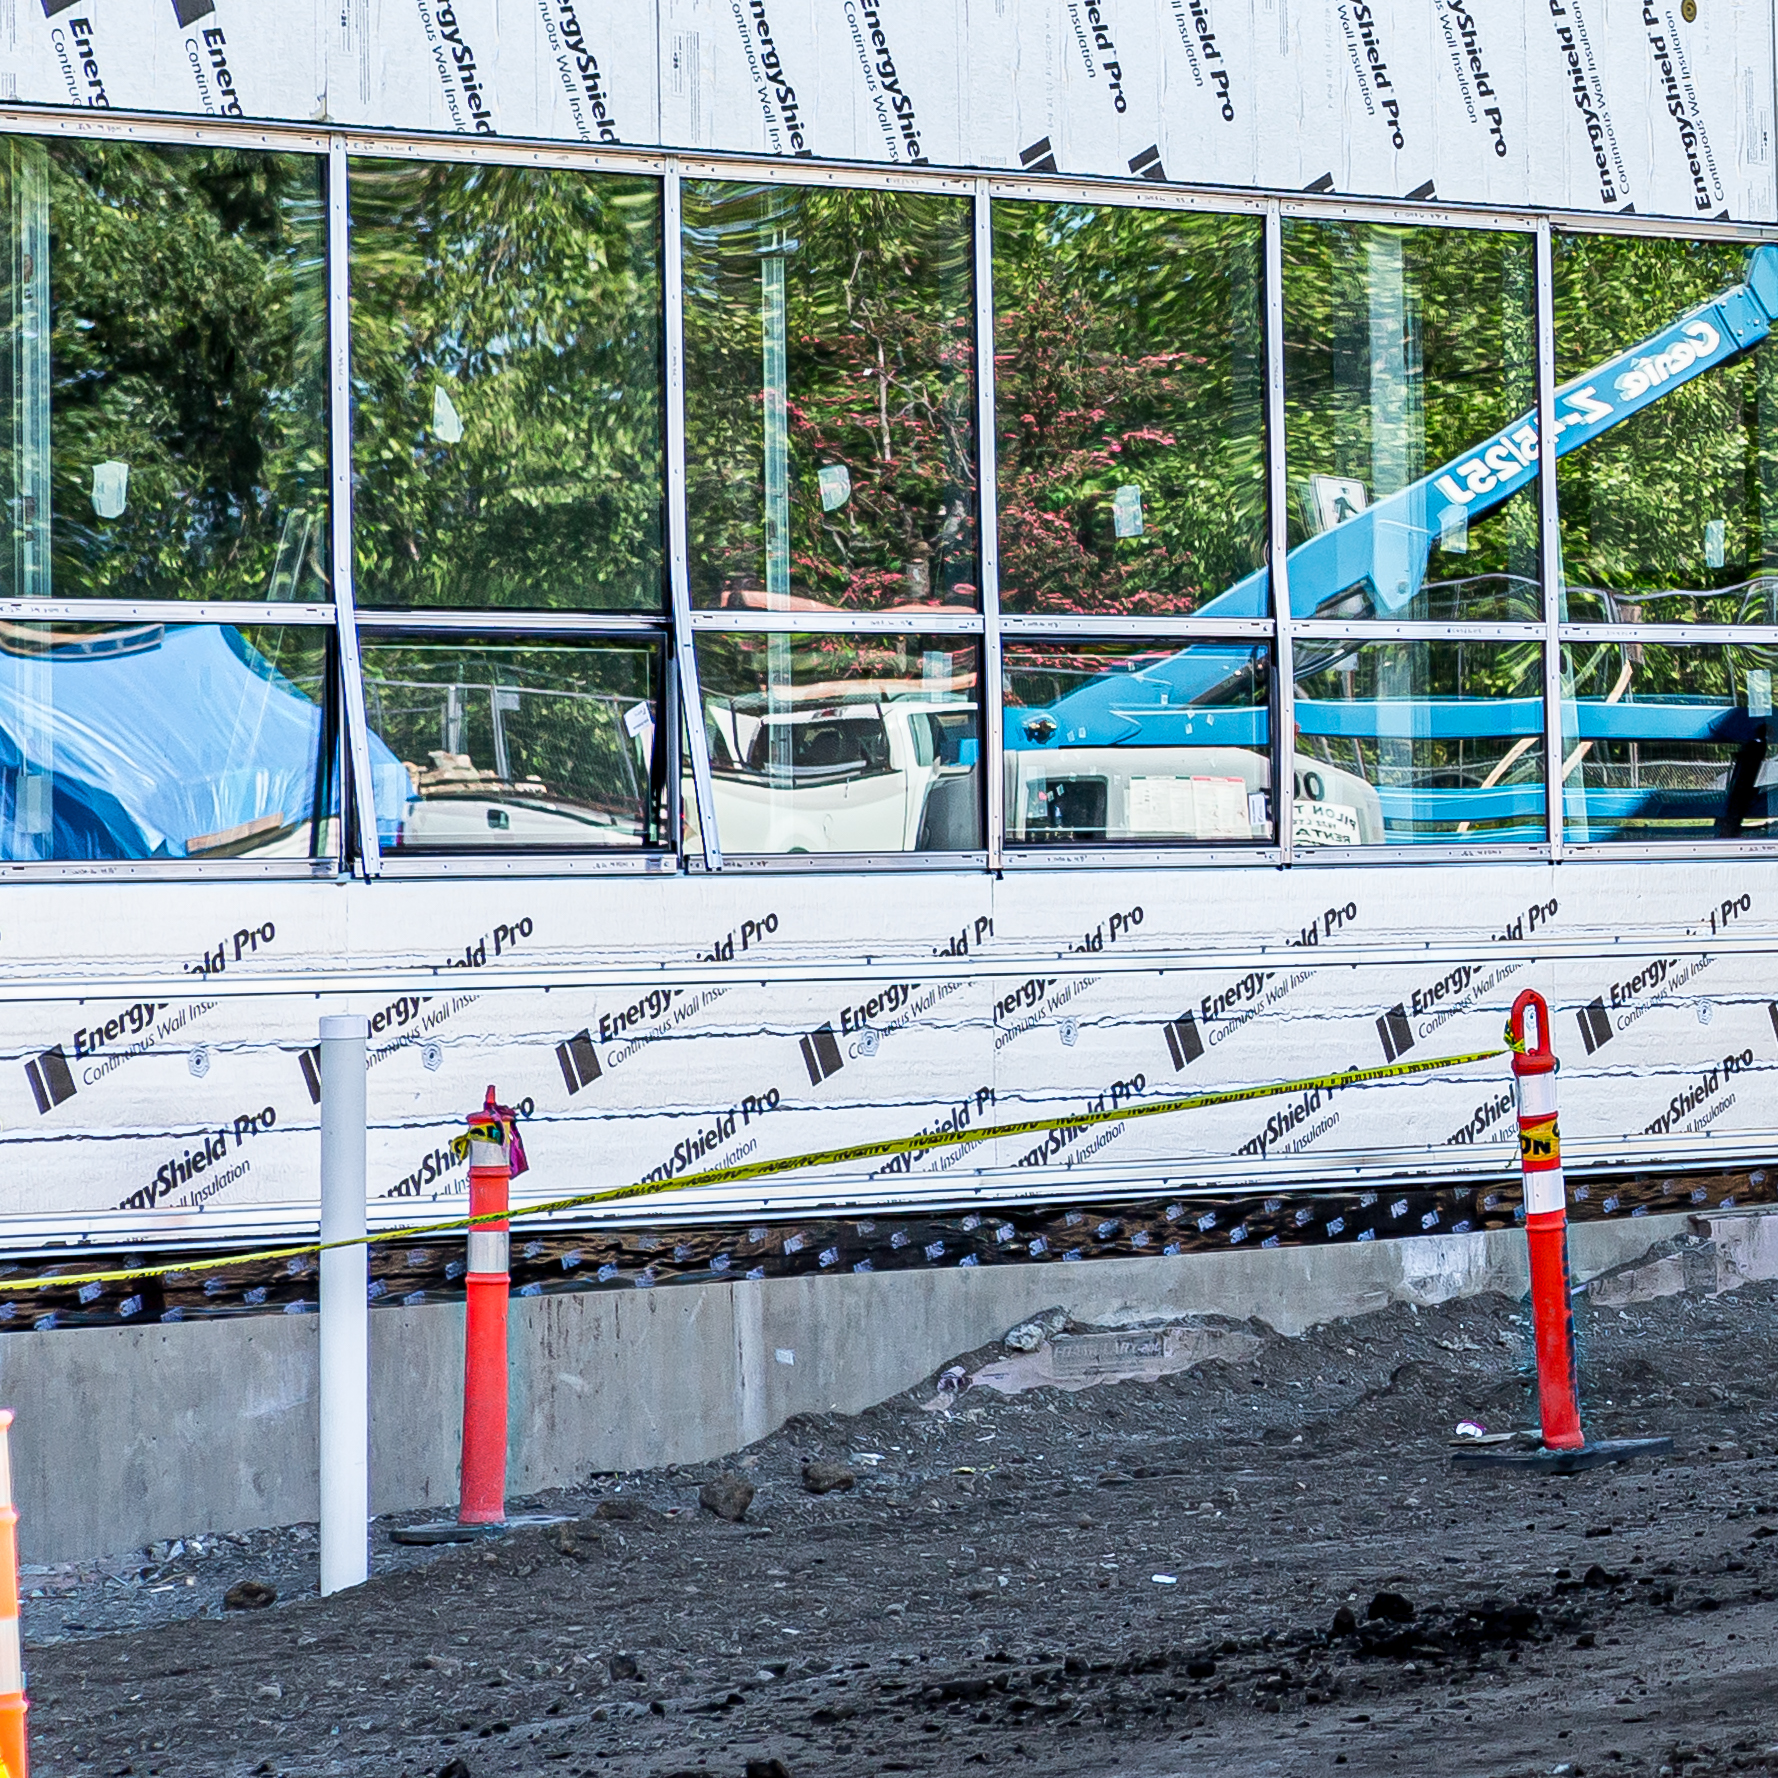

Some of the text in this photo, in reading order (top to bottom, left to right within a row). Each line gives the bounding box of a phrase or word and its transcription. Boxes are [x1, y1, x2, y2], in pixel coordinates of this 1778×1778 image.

[1068, 1, 1097, 80] Insulation
[1102, 60, 1127, 114] Pro
[1570, 0, 1630, 196] Continuous Wall Insulation
[1483, 107, 1507, 158] Pro
[1555, 26, 1616, 205] EnergyShield
[1648, 36, 1712, 211] EnergyShield
[740, 911, 780, 950] Pro
[1323, 900, 1357, 938] Pro
[1418, 994, 1471, 1039] Continuous
[1616, 987, 1666, 1032] Continuous
[82, 1032, 152, 1086] Continuous
[740, 1086, 781, 1127] Pro
[1693, 1091, 1736, 1134] Insulation
[1287, 1111, 1340, 1157] Insulation
[189, 1157, 250, 1207] Insulation
